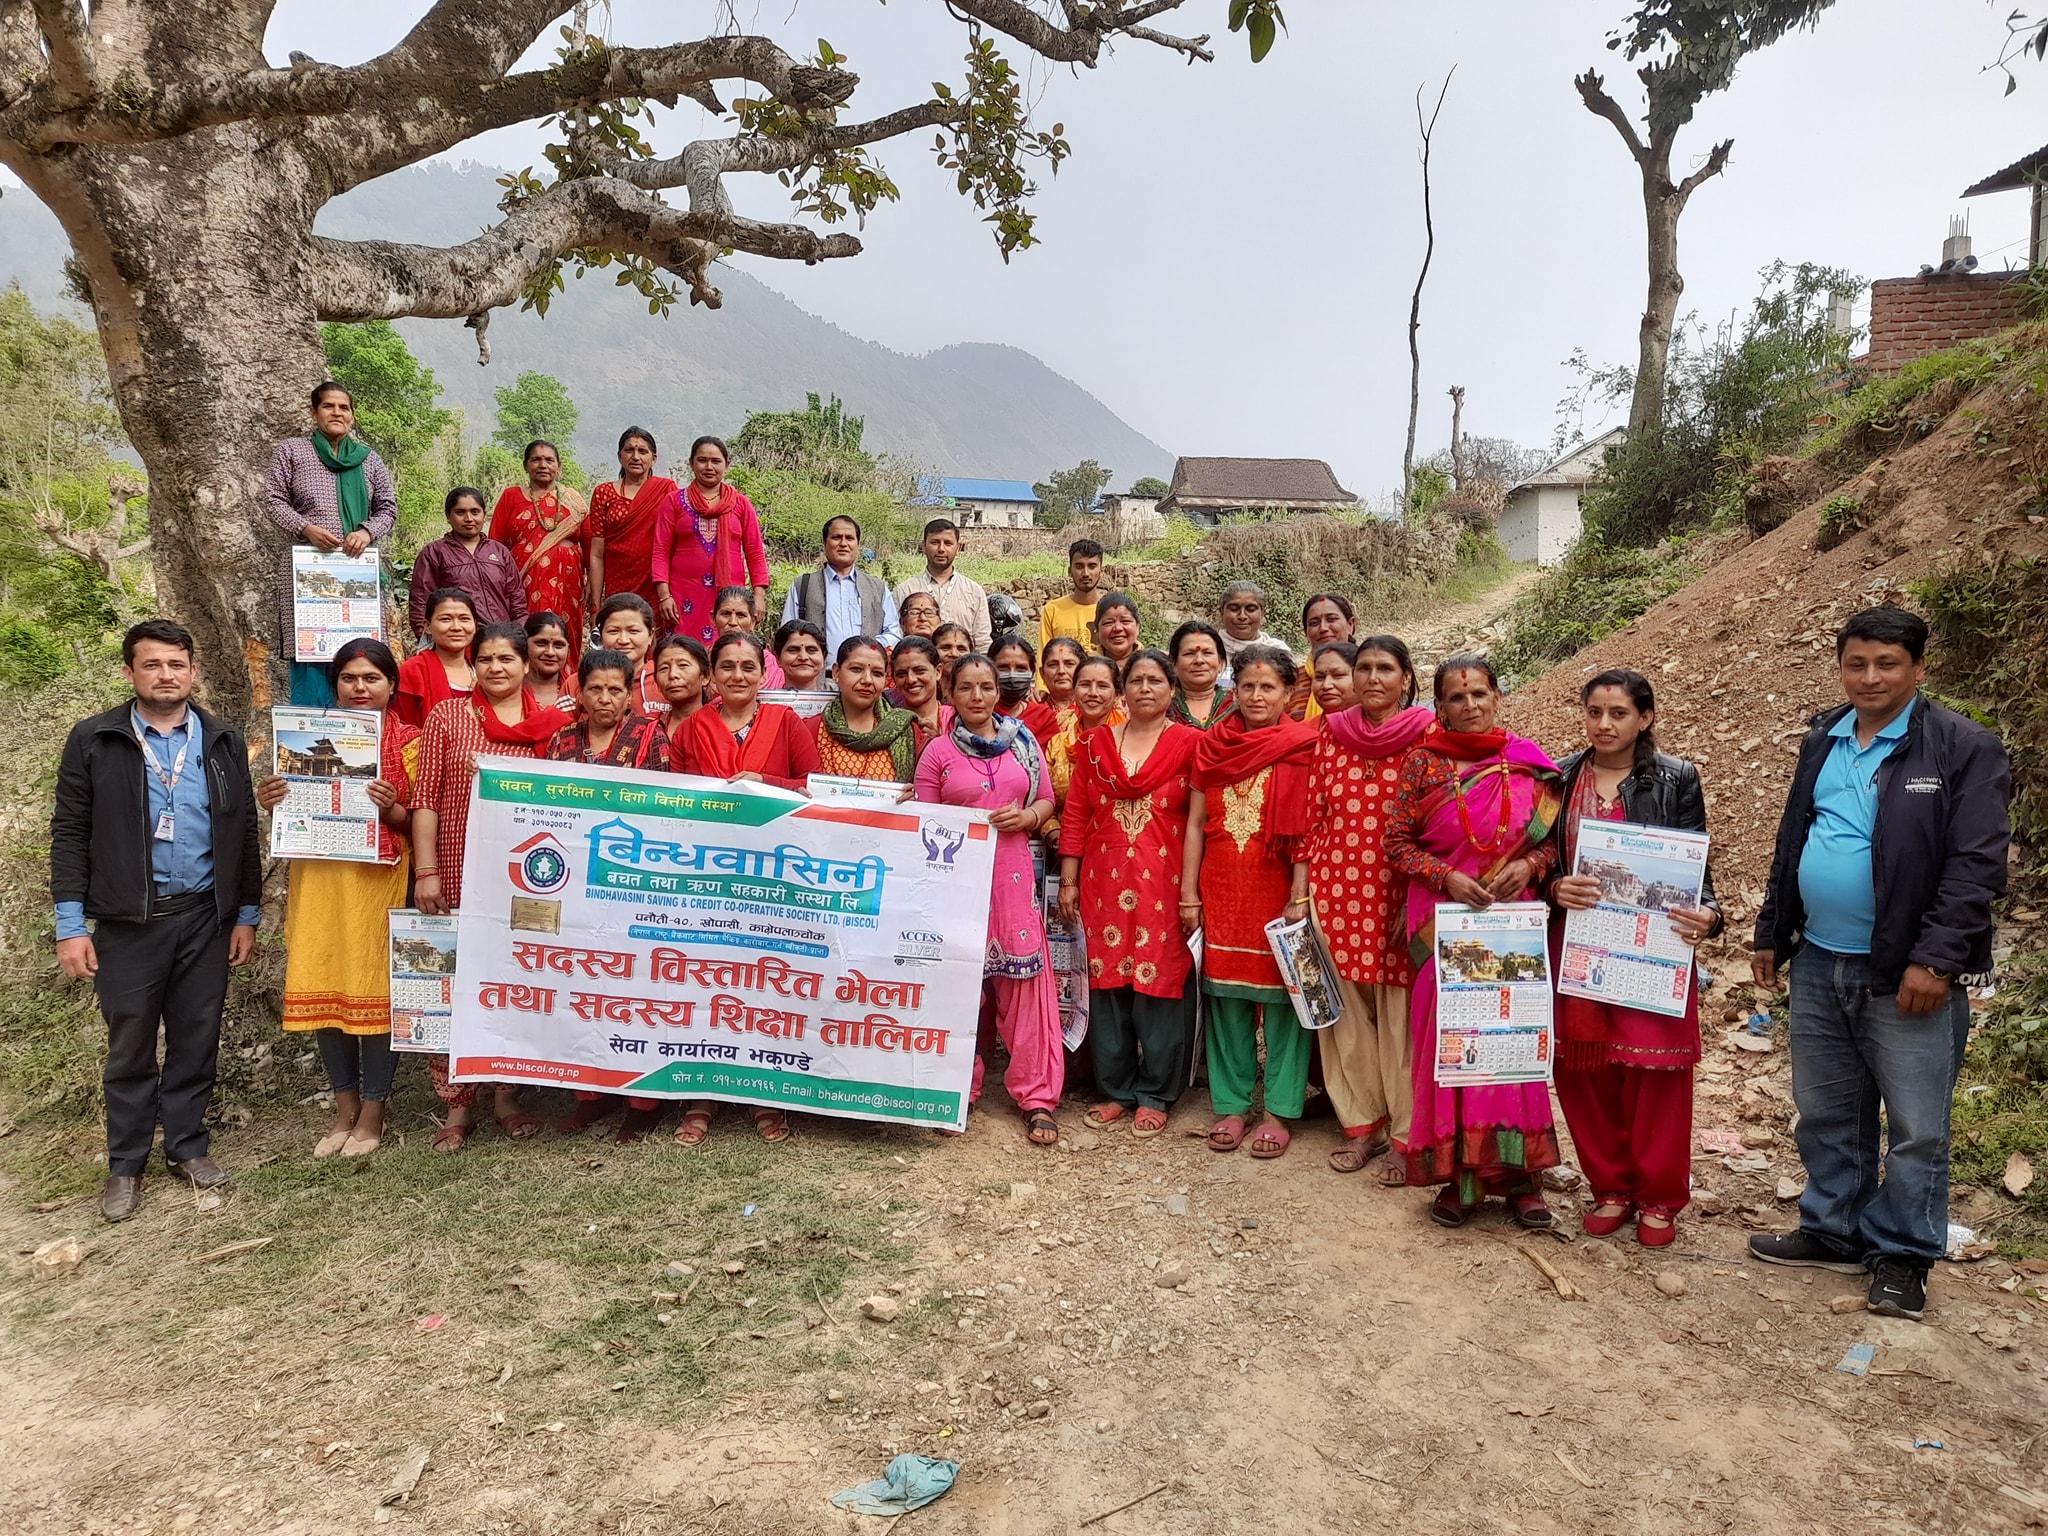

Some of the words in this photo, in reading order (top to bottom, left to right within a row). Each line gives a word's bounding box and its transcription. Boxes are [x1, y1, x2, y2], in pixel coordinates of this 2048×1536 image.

[545, 781, 596, 801] सुरक्षित
[602, 789, 612, 802] र
[653, 791, 695, 809] वित्तीय
[606, 870, 643, 888] बचत
[649, 874, 678, 891] तथा
[686, 877, 722, 895] ऋण
[730, 878, 786, 902] सहकारी
[794, 889, 833, 909] संस्था
[839, 890, 864, 912] लि.
[585, 888, 645, 905] BINDHAVASINI
[647, 893, 679, 907] SAVING
[680, 897, 688, 908] &
[690, 897, 722, 912] CREDIT
[723, 901, 785, 919] CO-OPERATIVE
[785, 905, 822, 922] SOCIETY
[823, 910, 841, 926] LTD.
[842, 912, 879, 930] (BISCOL)
[897, 943, 941, 958] SILVER
[898, 930, 944, 944] ACCESS
[511, 939, 637, 981] सदस्य
[649, 947, 825, 999] विस्तारित
[834, 967, 927, 1009] भेला
[477, 980, 558, 1015] तथा
[568, 991, 698, 1029] सदस्य
[709, 992, 811, 1040] शिक्षा
[819, 1012, 952, 1056] तालिम
[609, 1034, 648, 1055] सेवा
[657, 1039, 740, 1061] कार्यालय
[749, 1047, 814, 1071] भकुण्डे
[490, 1060, 580, 1078] www.biscol.org.np
[671, 1071, 691, 1085] फोन
[782, 1083, 816, 1099] Email:
